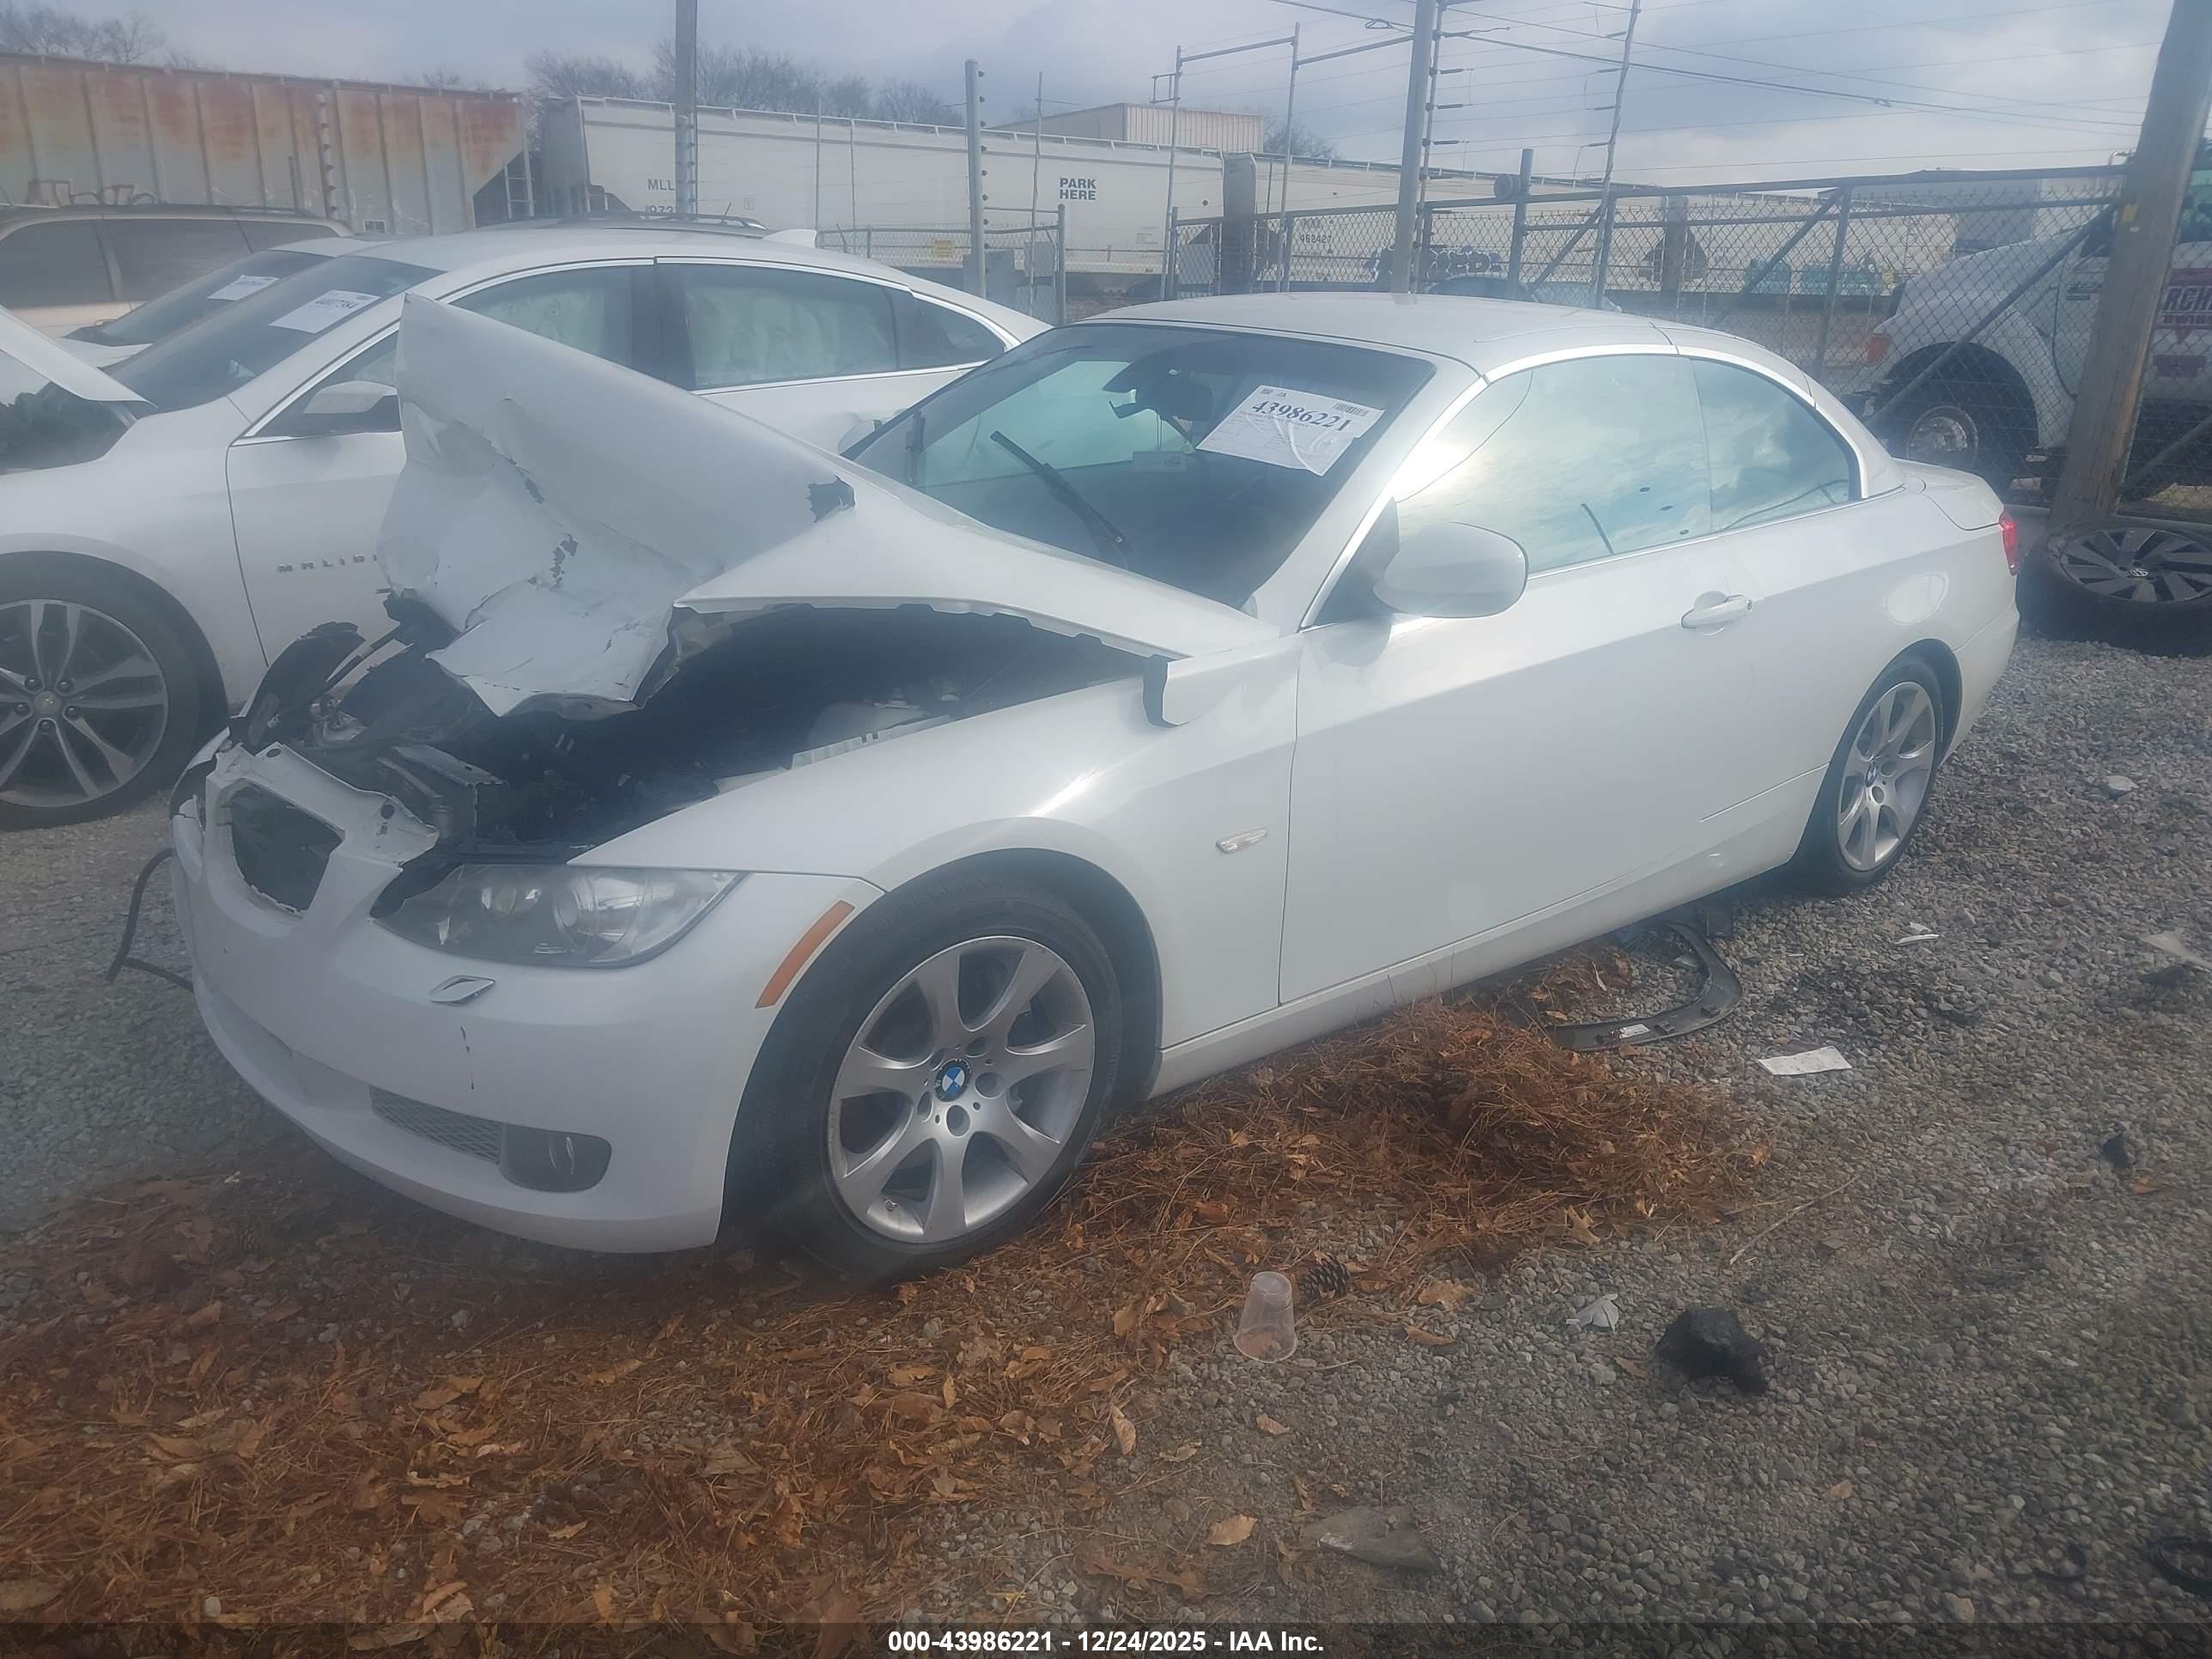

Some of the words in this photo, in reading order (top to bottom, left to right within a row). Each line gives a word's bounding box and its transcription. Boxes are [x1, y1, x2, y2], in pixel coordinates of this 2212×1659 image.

[1059, 177, 1097, 189] PARK
[1059, 190, 1097, 201] HERE
[1251, 399, 1354, 433] 43986221
